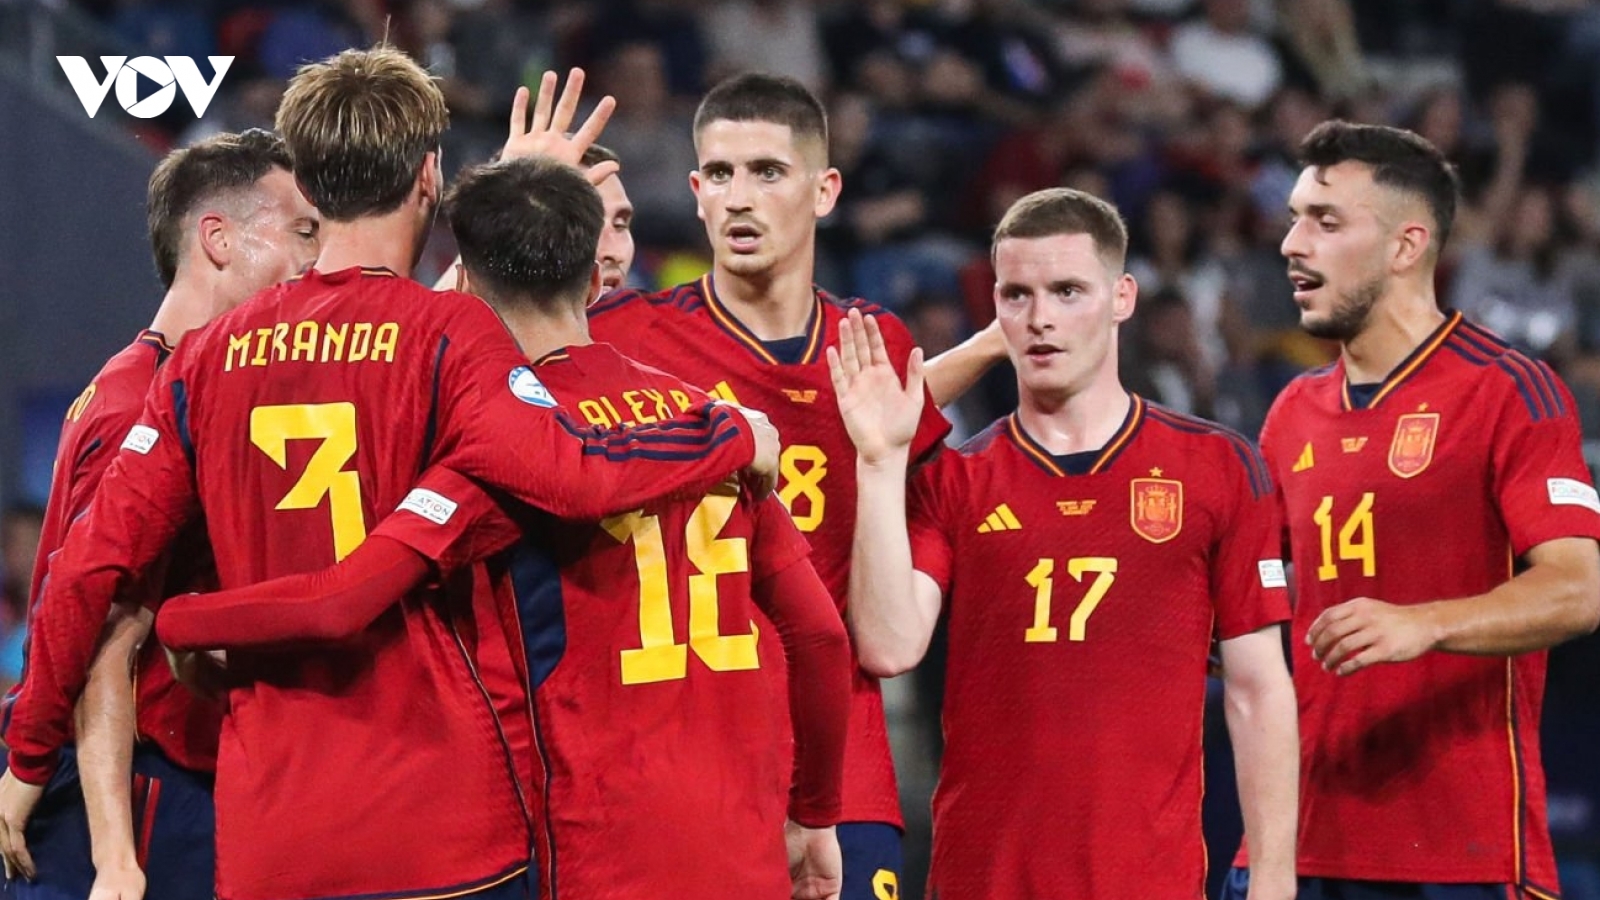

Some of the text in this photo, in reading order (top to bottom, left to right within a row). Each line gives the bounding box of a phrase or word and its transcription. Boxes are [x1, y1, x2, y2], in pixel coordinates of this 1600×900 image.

[224, 320, 400, 372] MIRANDA
[578, 388, 674, 430] ALEX
[250, 402, 368, 563] 3
[780, 445, 828, 532] 8
[1313, 492, 1376, 582] 14
[1024, 557, 1118, 643] 17
